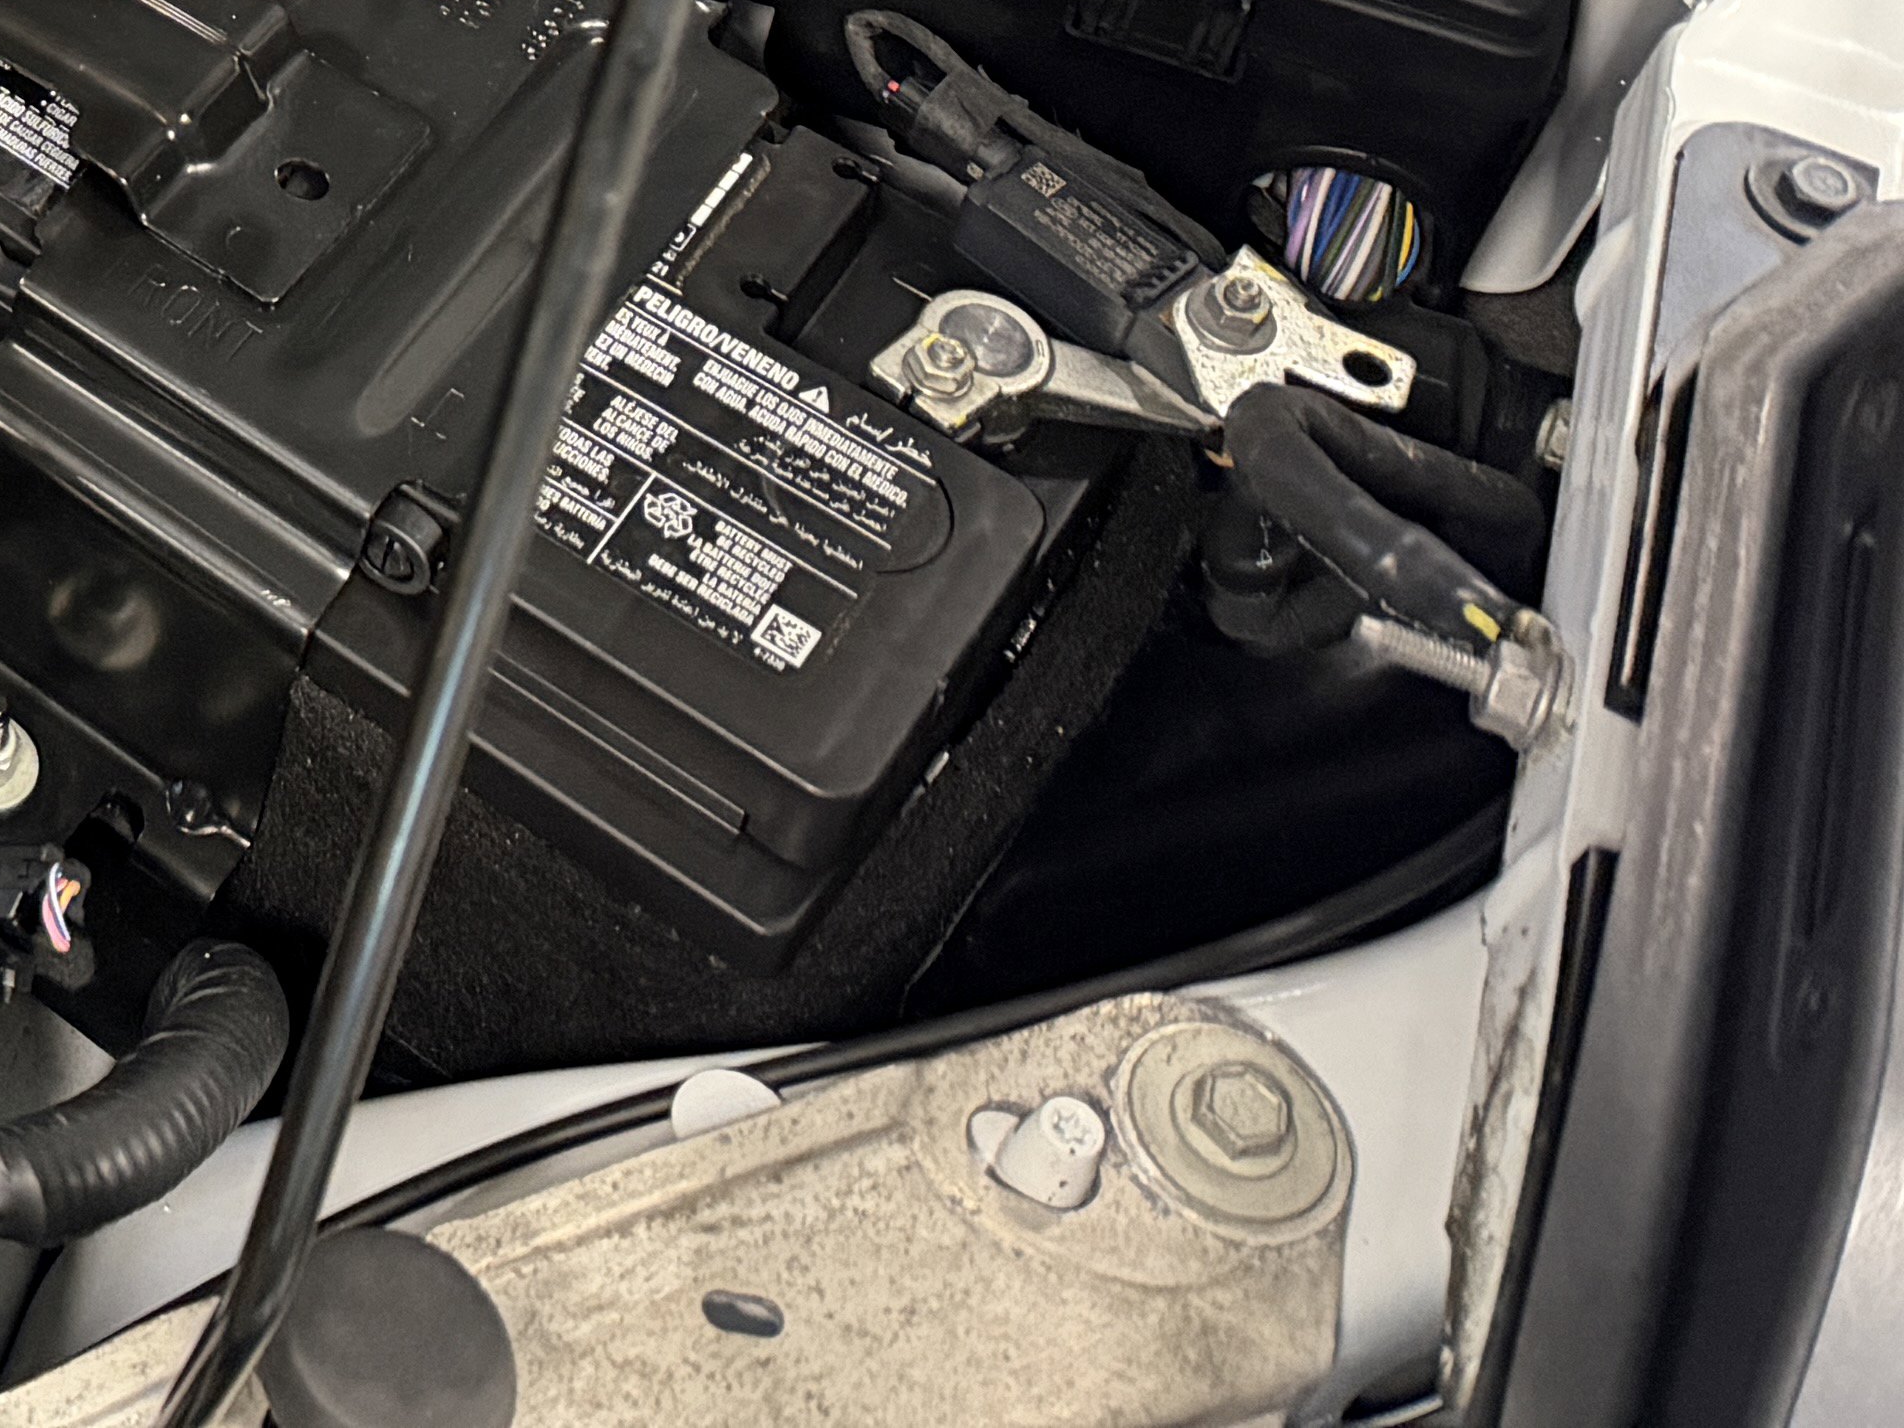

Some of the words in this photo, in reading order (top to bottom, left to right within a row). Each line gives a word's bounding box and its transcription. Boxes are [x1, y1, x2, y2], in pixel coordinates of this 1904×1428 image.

[608, 341, 629, 360] UN
[629, 315, 661, 341] YEUX
[630, 282, 804, 395] PELIGRO/VENENO
[591, 417, 619, 439] LOS
[599, 405, 654, 444] ALCANCE
[648, 435, 670, 454] DE
[608, 391, 661, 430] ALÉJESE
[653, 420, 682, 444] DEL
[690, 371, 720, 395] CON
[713, 384, 753, 414] AGUA.
[745, 403, 789, 436] ACUDA
[781, 423, 830, 459] RÁPIDO
[822, 449, 852, 473] CON
[845, 463, 866, 481] EL
[859, 470, 914, 510] MÉDICO.
[699, 357, 760, 400] ENJUAGUE
[754, 388, 781, 410] LOS
[774, 401, 808, 427] OJOS
[800, 416, 900, 482] INMEDIATAMENTE
[588, 445, 616, 467] LAS
[684, 532, 706, 550] LA
[699, 541, 753, 578] BATTERIE
[748, 570, 779, 594] DOIT
[712, 519, 764, 555] BATTERY
[758, 547, 794, 573] MUST
[713, 534, 734, 551] BE
[728, 543, 787, 583] RECYCLED
[645, 552, 679, 579] DEBE
[672, 569, 701, 592] SER
[694, 582, 758, 626] RECICLADA
[699, 571, 721, 590] LA
